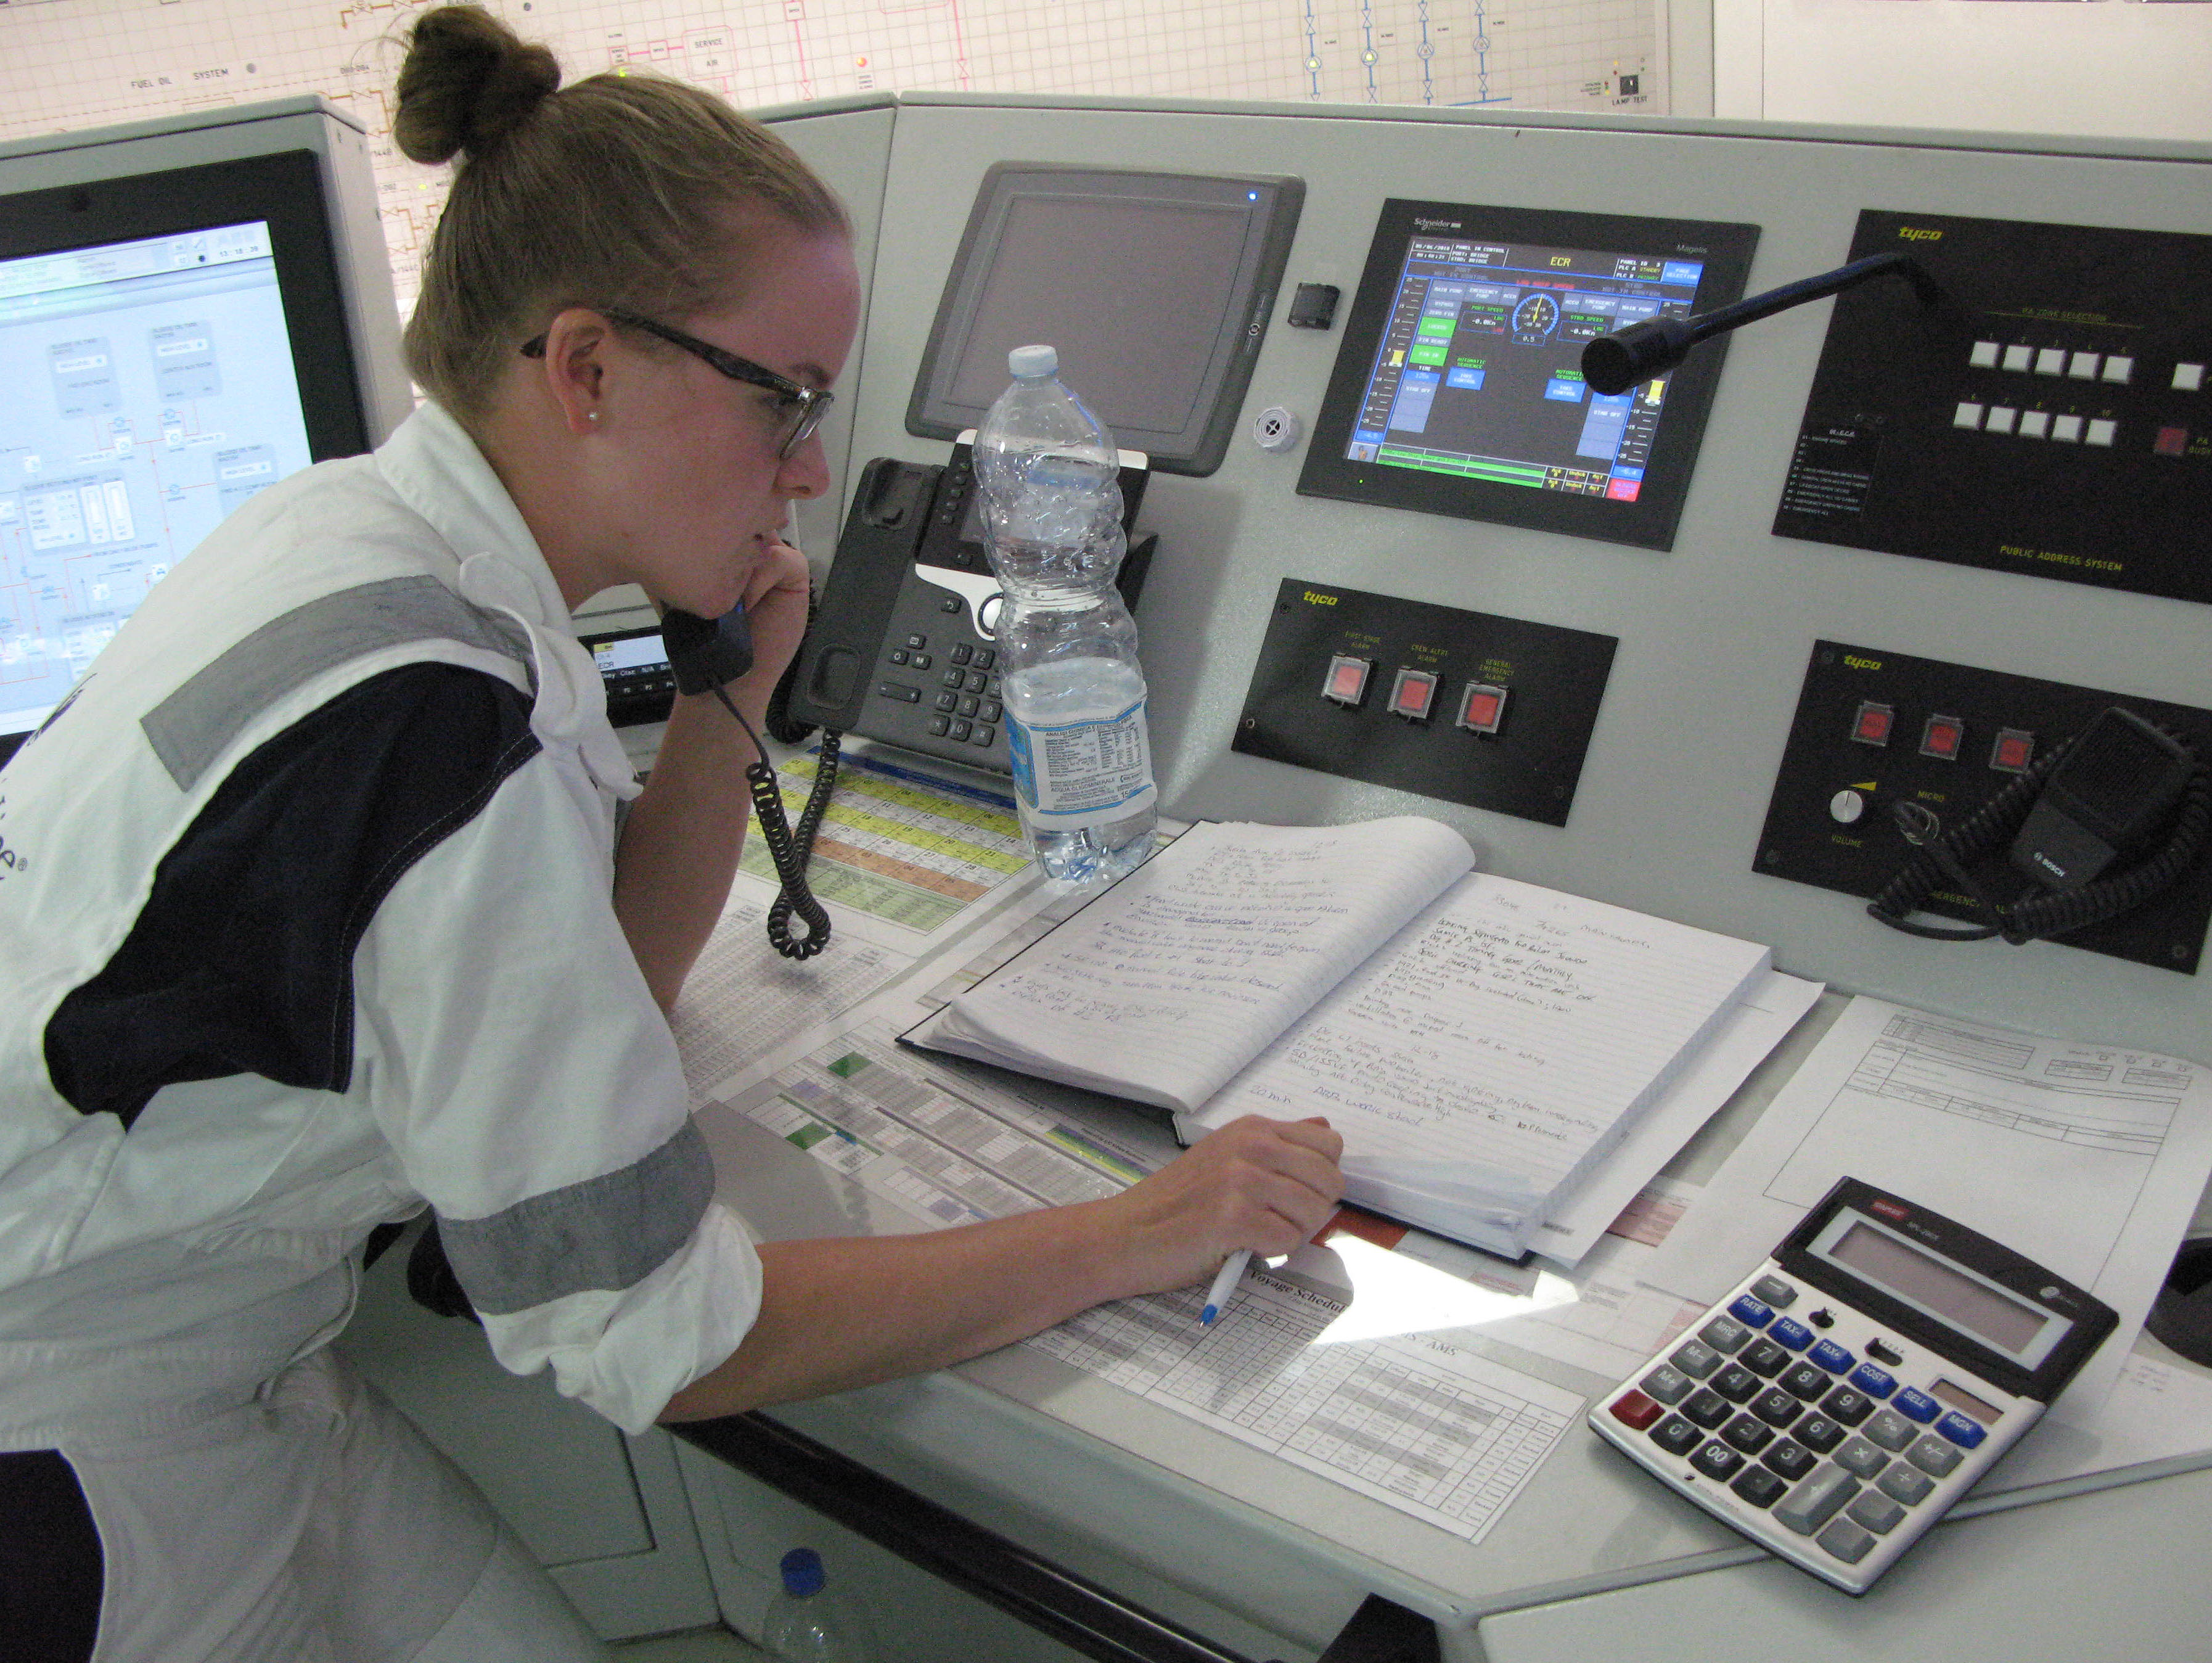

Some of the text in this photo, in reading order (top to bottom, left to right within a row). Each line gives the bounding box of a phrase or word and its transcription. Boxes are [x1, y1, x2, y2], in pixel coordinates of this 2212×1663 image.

[694, 38, 723, 49] SERVICE
[706, 59, 718, 67] AIR
[193, 69, 229, 80] SYSTEM
[131, 80, 154, 89] FUEL
[1414, 218, 1451, 231] Schneider
[1898, 226, 1944, 241] tyco
[1550, 257, 1571, 268] ECR
[1555, 369, 1584, 377] AUTOMATI
[2000, 545, 2123, 572] PUBLIC ADDRESS SYSTEM
[1303, 591, 1338, 606] tyco
[980, 652, 986, 662] 2
[1844, 654, 1882, 671] tyco
[949, 671, 956, 681] 4
[972, 676, 979, 686] 5
[943, 696, 993, 713] 7 8 9
[957, 724, 963, 733] 0
[1917, 789, 1944, 803] MICRO
[1831, 834, 1864, 848] VOLUME
[2042, 858, 2065, 877] BOSCH
[1250, 1270, 1346, 1314] Voyage Schedul
[1740, 1295, 1765, 1314] RATE
[1426, 1340, 1459, 1357] AMS
[1758, 1346, 1854, 1406] 7 8 9
[1861, 1364, 1888, 1382] COST
[1727, 1373, 1825, 1433] 4 5 6
[1904, 1390, 1927, 1408] SELL
[1948, 1414, 1972, 1431] MGN
[1668, 1423, 1729, 1463] 0 00
[1739, 1423, 1796, 1460] 2 3
